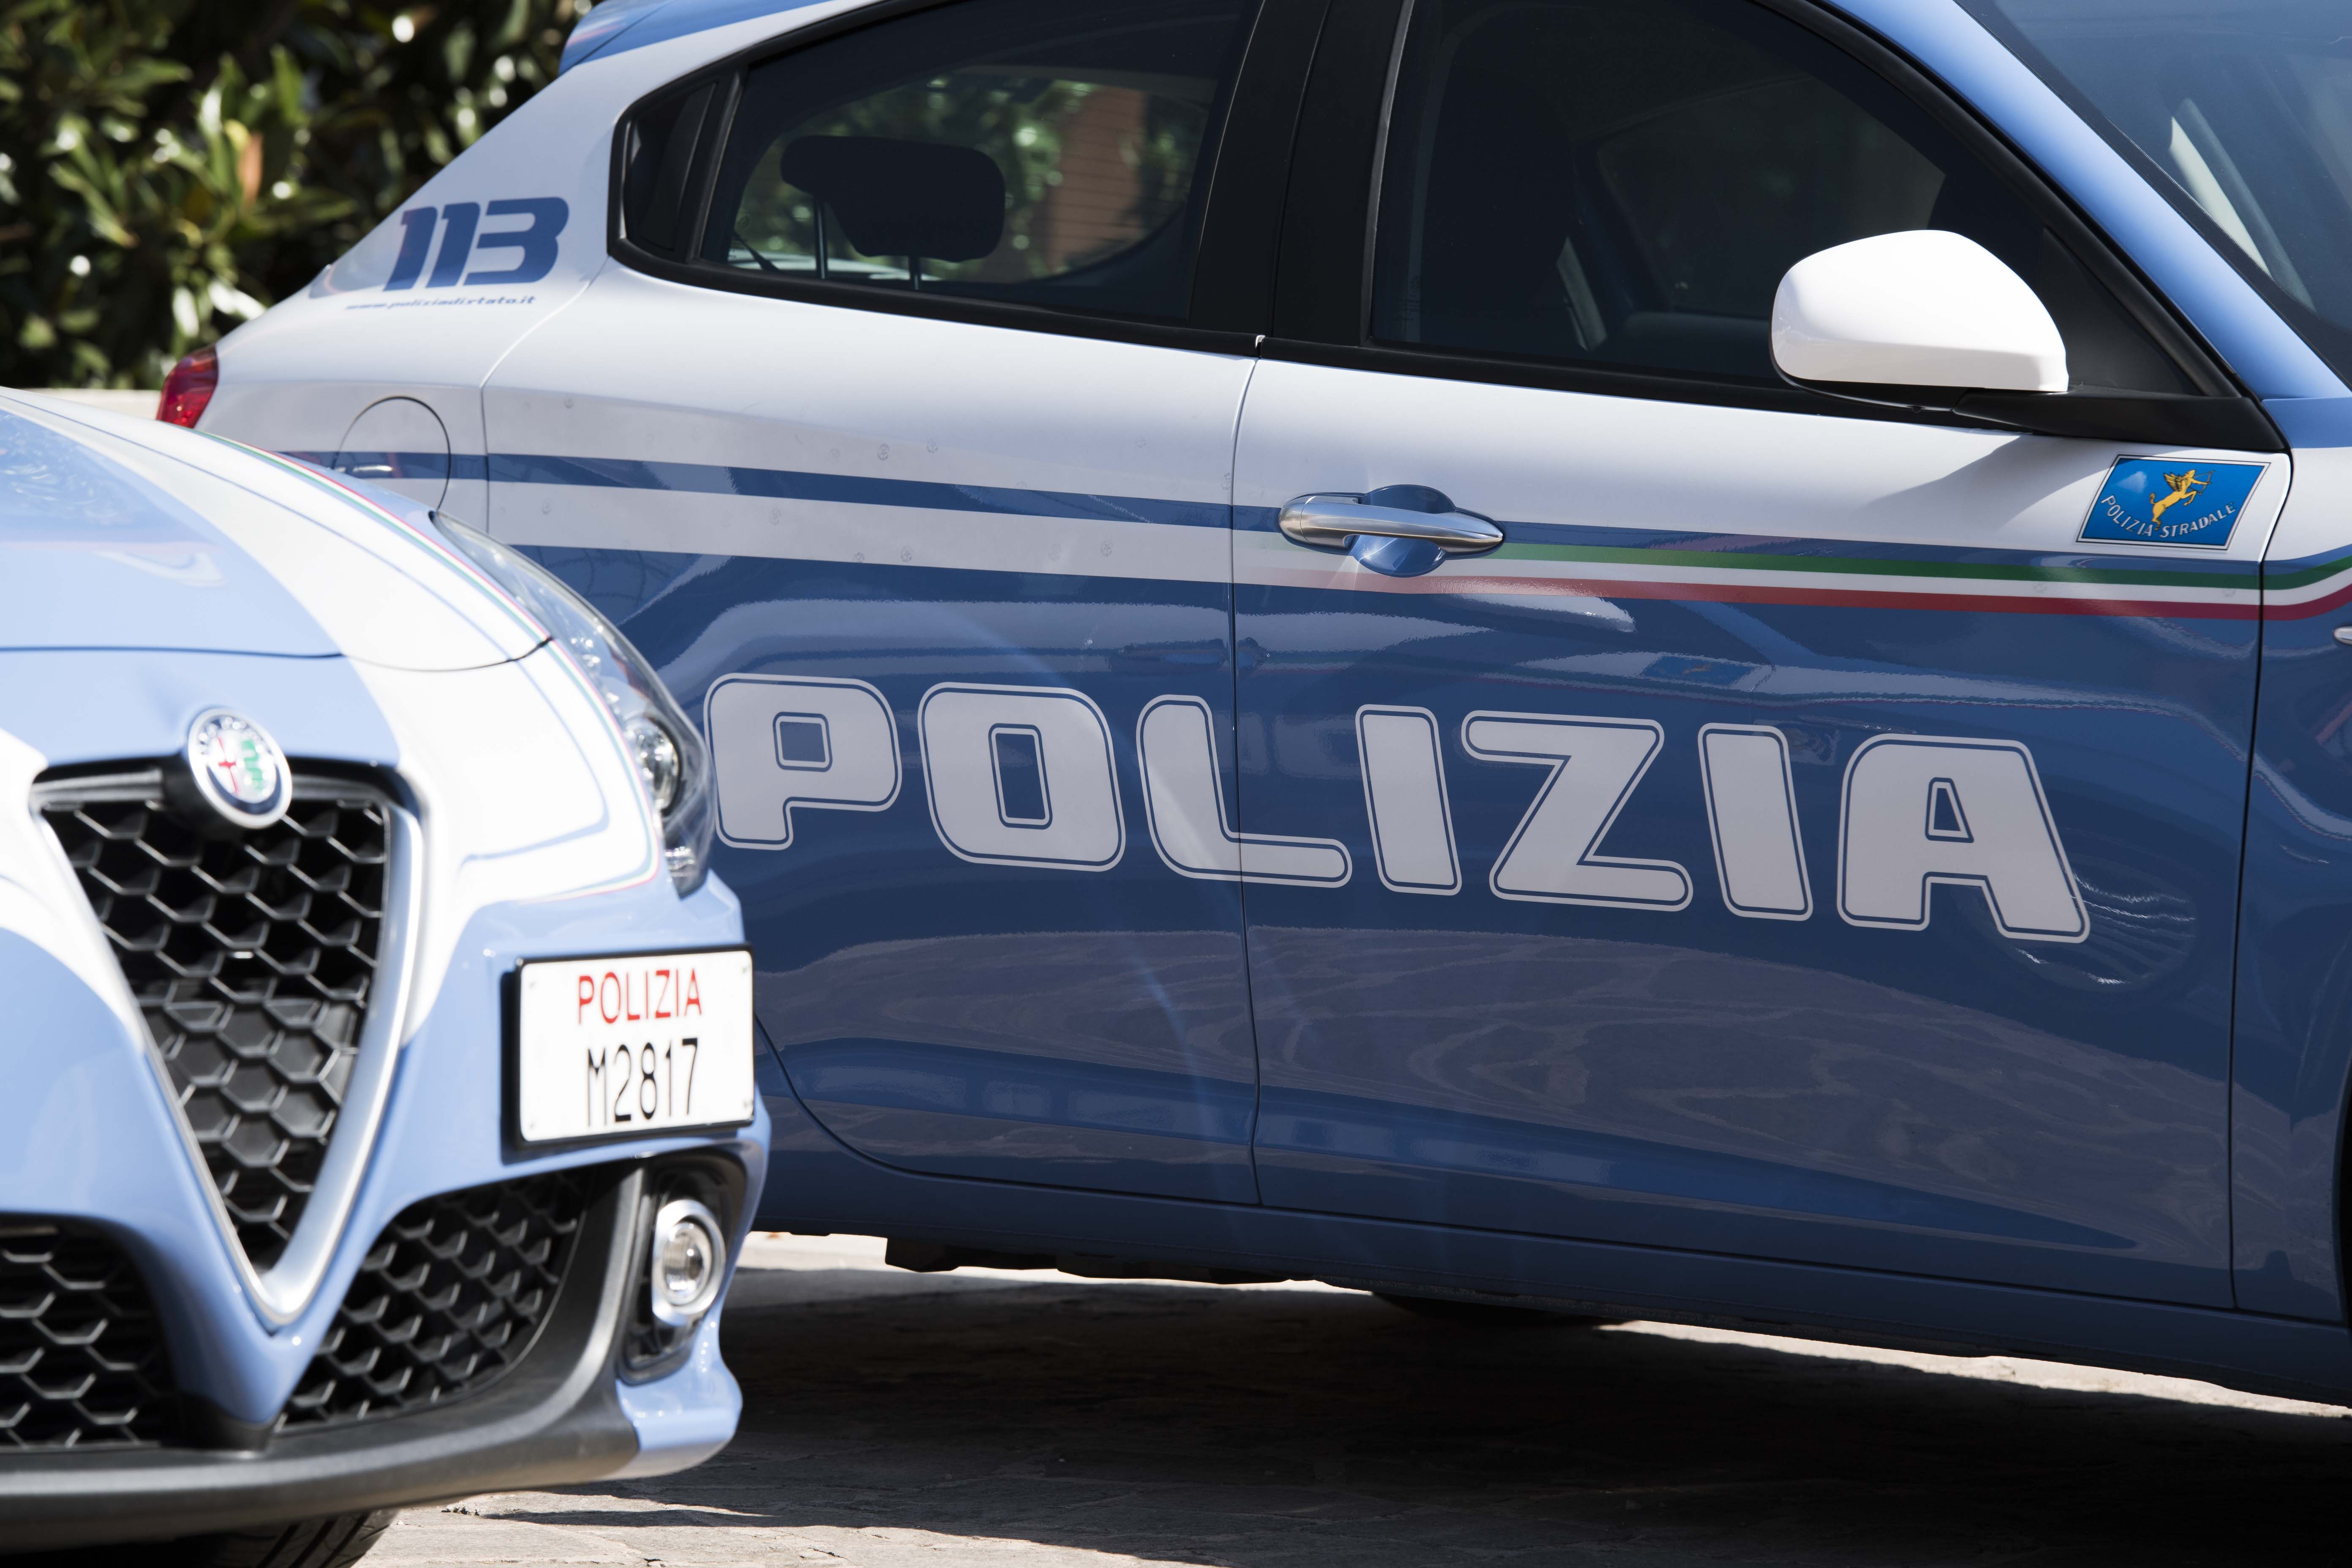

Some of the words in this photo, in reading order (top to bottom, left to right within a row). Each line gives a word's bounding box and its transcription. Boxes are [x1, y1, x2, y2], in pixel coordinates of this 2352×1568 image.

[382, 197, 569, 291] 113
[2101, 495, 2153, 537] POLIZIA
[2159, 502, 2237, 539] STRADALE
[704, 672, 2090, 944] POLIZIA
[577, 968, 702, 1024] POLIZIA
[588, 1037, 699, 1127] M2817
